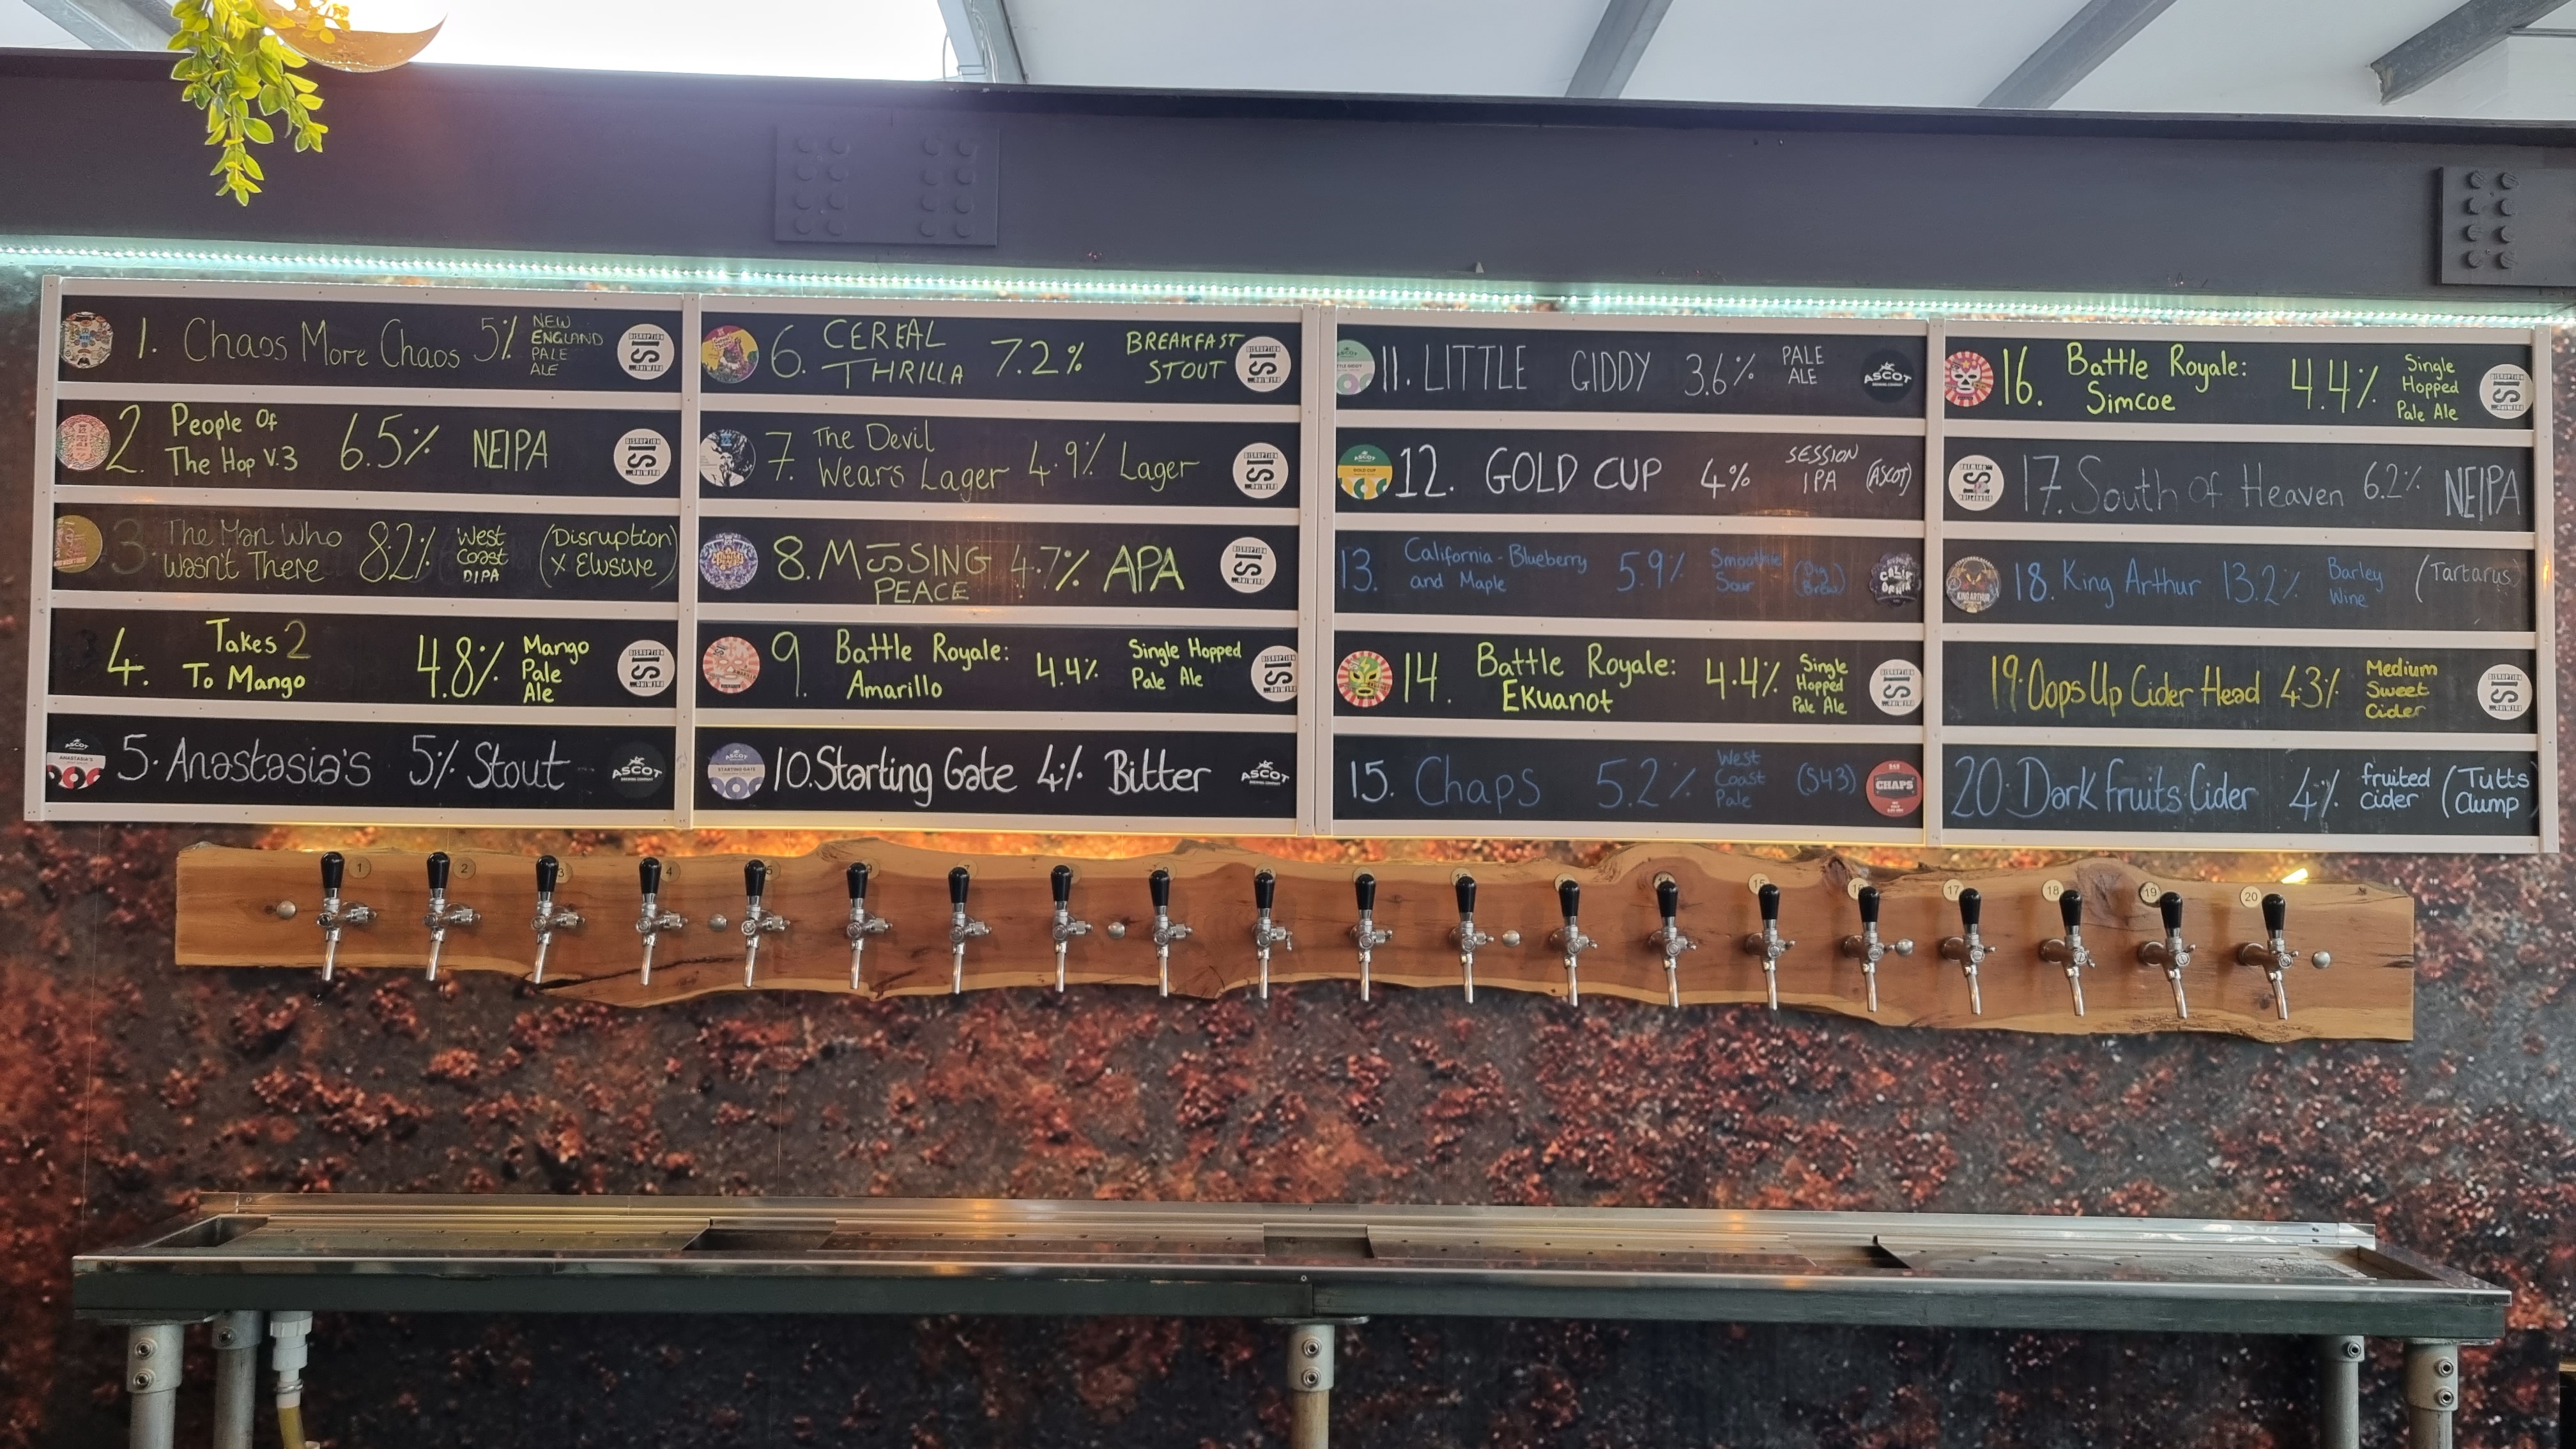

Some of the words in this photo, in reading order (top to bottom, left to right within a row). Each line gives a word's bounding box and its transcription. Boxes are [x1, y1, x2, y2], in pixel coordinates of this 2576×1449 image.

[533, 315, 571, 328] NEW
[824, 319, 946, 350] CEREAL
[139, 317, 157, 359] 1.
[185, 317, 288, 362] Chaos
[302, 320, 369, 367] More
[381, 319, 460, 368] Chaos
[474, 316, 518, 362] 5%
[531, 330, 604, 346] ENGLAND
[772, 325, 806, 378] 6.
[1126, 331, 1245, 355] BREAKFAST
[532, 347, 567, 361] PALE
[991, 339, 1084, 376] 7.2%
[1782, 346, 1825, 365] PALE
[2067, 342, 2149, 379] Battle
[2171, 343, 2247, 393] Royale:
[2404, 354, 2455, 381] Single
[530, 363, 558, 376] ALE
[822, 358, 963, 388] THRILLA
[1145, 360, 1227, 384] STOUT
[1382, 345, 1411, 392] 11.
[1425, 344, 1528, 391] LITTLE
[1571, 349, 1651, 392] GIDDY
[1684, 353, 1756, 396] 3.6%
[1789, 369, 1818, 385] ALE
[1864, 372, 1912, 384] ASCOT
[2003, 345, 2043, 406] 16.
[2087, 381, 2176, 415] Simcoe
[2292, 358, 2379, 413] 4.4%
[2402, 376, 2459, 399] Hopped
[172, 402, 241, 440] People
[256, 408, 278, 427] Of
[2397, 400, 2425, 422] Pale
[2434, 402, 2459, 421] Ale
[105, 404, 144, 474] 2.
[341, 413, 440, 471] 6.5%
[474, 429, 548, 471] NEIPA
[813, 427, 855, 448] The
[866, 419, 935, 452] Devil
[165, 446, 210, 475] The
[222, 447, 255, 477] Hop
[765, 432, 795, 481] 7.
[1029, 433, 1105, 486] 4.9%
[1120, 441, 1200, 492] Lager
[1786, 444, 1859, 466] SESSION
[819, 457, 905, 488] Wears
[921, 457, 1009, 502] Lager
[1395, 443, 1454, 498] 12.
[1486, 447, 1578, 494] GOLD
[1594, 457, 1662, 492] CUP
[1701, 457, 1751, 499] 4%
[1804, 469, 1837, 494] IPA
[1866, 458, 1913, 496] (ASCOT)
[2023, 454, 2063, 515] 17.
[2071, 455, 2178, 514] South
[2241, 462, 2343, 507] Heaven
[2364, 461, 2422, 500] 6.2%
[2445, 465, 2520, 522] NEIPA
[164, 519, 213, 546] The
[220, 519, 274, 547] Man
[281, 521, 342, 547] Who
[457, 525, 506, 547] West
[248, 551, 325, 582] There
[457, 548, 509, 565] Coast
[774, 535, 810, 580] 8.
[1010, 544, 1090, 591] 4.7%
[1103, 544, 1184, 594] APA
[1341, 548, 1378, 592] 13.
[1406, 537, 1493, 566] California
[1508, 544, 1588, 574] Blueberry
[1616, 549, 1687, 592] 5.9%
[463, 570, 500, 584] DIPA
[1410, 574, 1444, 589] and
[1459, 571, 1506, 595] Maple
[2015, 562, 2055, 602] 18.
[2063, 558, 2115, 608] King
[2125, 557, 2202, 596] Arthur
[2223, 561, 2300, 606] 13.2%
[2327, 556, 2384, 592] Barley
[874, 578, 969, 605] PEACE
[2329, 589, 2368, 608] Wine
[206, 618, 277, 654] Takes
[284, 619, 311, 659] 2
[523, 634, 589, 665] Mango
[836, 629, 912, 664] Battle
[933, 632, 1009, 671] Royale:
[1128, 638, 1180, 667] Single
[1188, 638, 1242, 663] Hopped
[108, 627, 149, 686] 4.
[417, 634, 505, 698] 4.8%
[522, 658, 562, 683] Pale
[772, 631, 808, 698] 9.
[1037, 652, 1099, 688] 4.4%
[1477, 641, 1564, 678] Battle
[1588, 643, 1676, 689] Royale:
[1800, 654, 1848, 680] Single
[2366, 657, 2438, 677] Medium
[183, 663, 213, 688] To
[228, 664, 305, 699] Mango
[847, 670, 943, 700] Amarillo
[1133, 668, 1166, 691] Pale
[1180, 666, 1204, 687] Ale
[1405, 651, 1452, 703] 14.
[1706, 657, 1781, 700] 4.4%
[1796, 675, 1844, 700] Hopped
[2090, 661, 2123, 717] Up
[2131, 664, 2193, 708] Cider
[2201, 665, 2260, 707] Head
[2366, 681, 2430, 697] Sweet
[523, 682, 555, 703] Ale
[1503, 678, 1613, 713] Ekuanot
[1792, 696, 1816, 714] Pale
[1823, 696, 1848, 714] Ale
[2365, 704, 2426, 719] Cider
[118, 733, 158, 781] 5.
[166, 737, 371, 786] Anastasia's
[409, 735, 459, 790] 5%
[467, 740, 571, 790] Stout
[611, 763, 663, 779] ASCOT
[944, 746, 1018, 793] Gate
[1037, 744, 1083, 792] 4%
[1105, 748, 1212, 795] Bitter
[1717, 749, 1761, 766] West
[1240, 769, 1291, 784] ASCOT
[1351, 760, 1395, 803] 15.
[1416, 754, 1540, 814] Chaps
[1597, 758, 1696, 809] 5.2%
[1715, 769, 1767, 786] Coast
[1798, 762, 1856, 796] (S43)
[1875, 779, 1915, 790] CHAPS
[1716, 790, 1752, 808] Pale
[2190, 763, 2260, 811] Cider
[2289, 767, 2340, 822] 4%
[358, 863, 361, 872] 1
[461, 864, 468, 873] 2
[666, 867, 672, 876] 4
[1947, 885, 1959, 894] 17
[2047, 886, 2059, 895] 18
[2144, 888, 2157, 898] 19
[2244, 893, 2257, 901] 20
